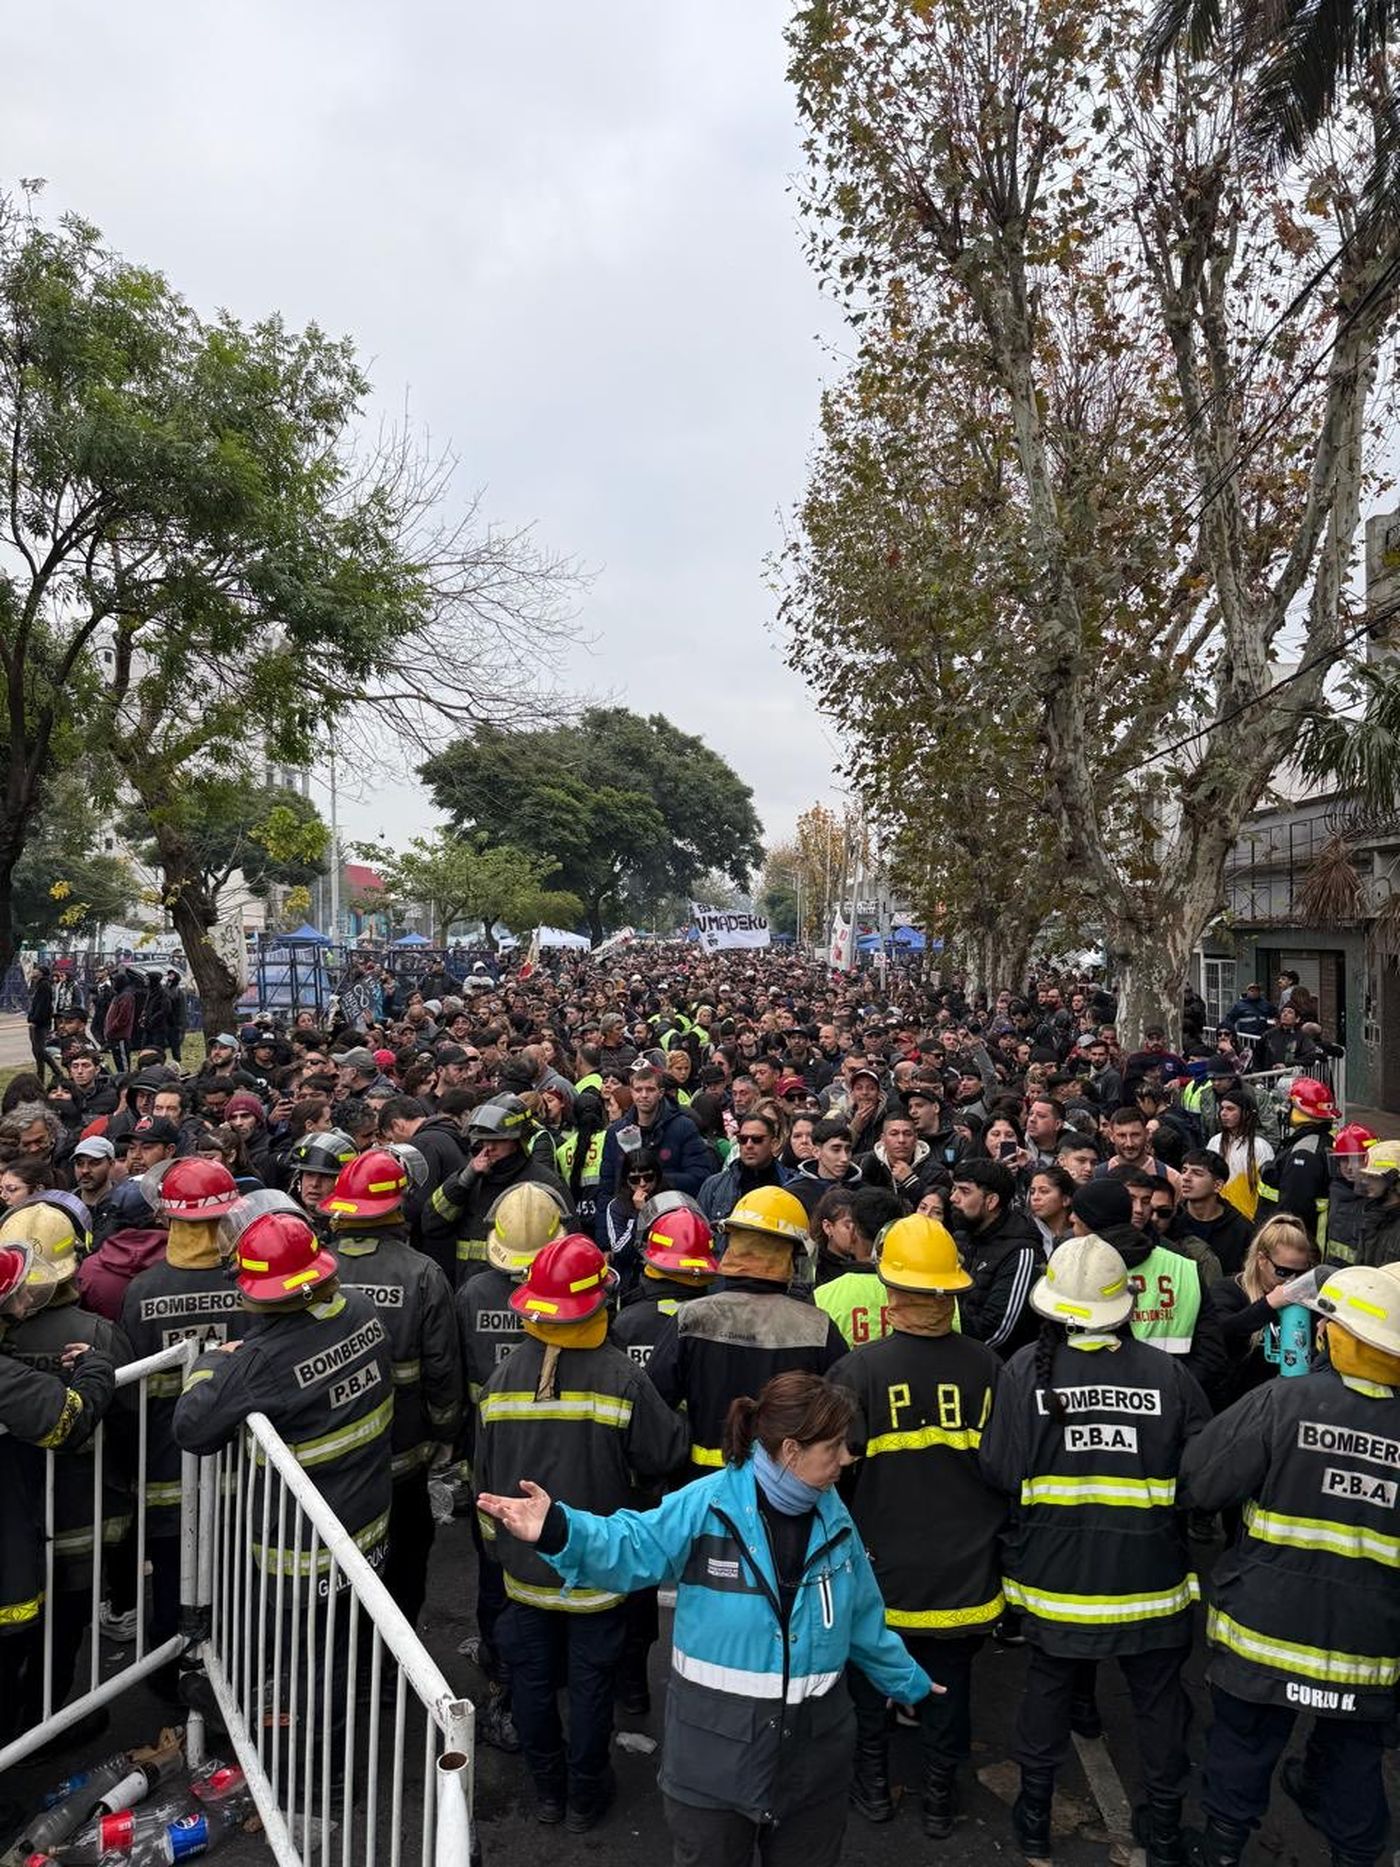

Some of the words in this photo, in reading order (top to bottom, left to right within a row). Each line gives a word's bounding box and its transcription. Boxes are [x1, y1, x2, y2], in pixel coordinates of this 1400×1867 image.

[299, 1321, 382, 1383] BOMBEROS
[334, 1368, 378, 1403] P.B.A.
[1070, 1427, 1133, 1448] P.B.A.
[1302, 1425, 1400, 1464] BOMBER
[1328, 1471, 1391, 1504] P.B.A.
